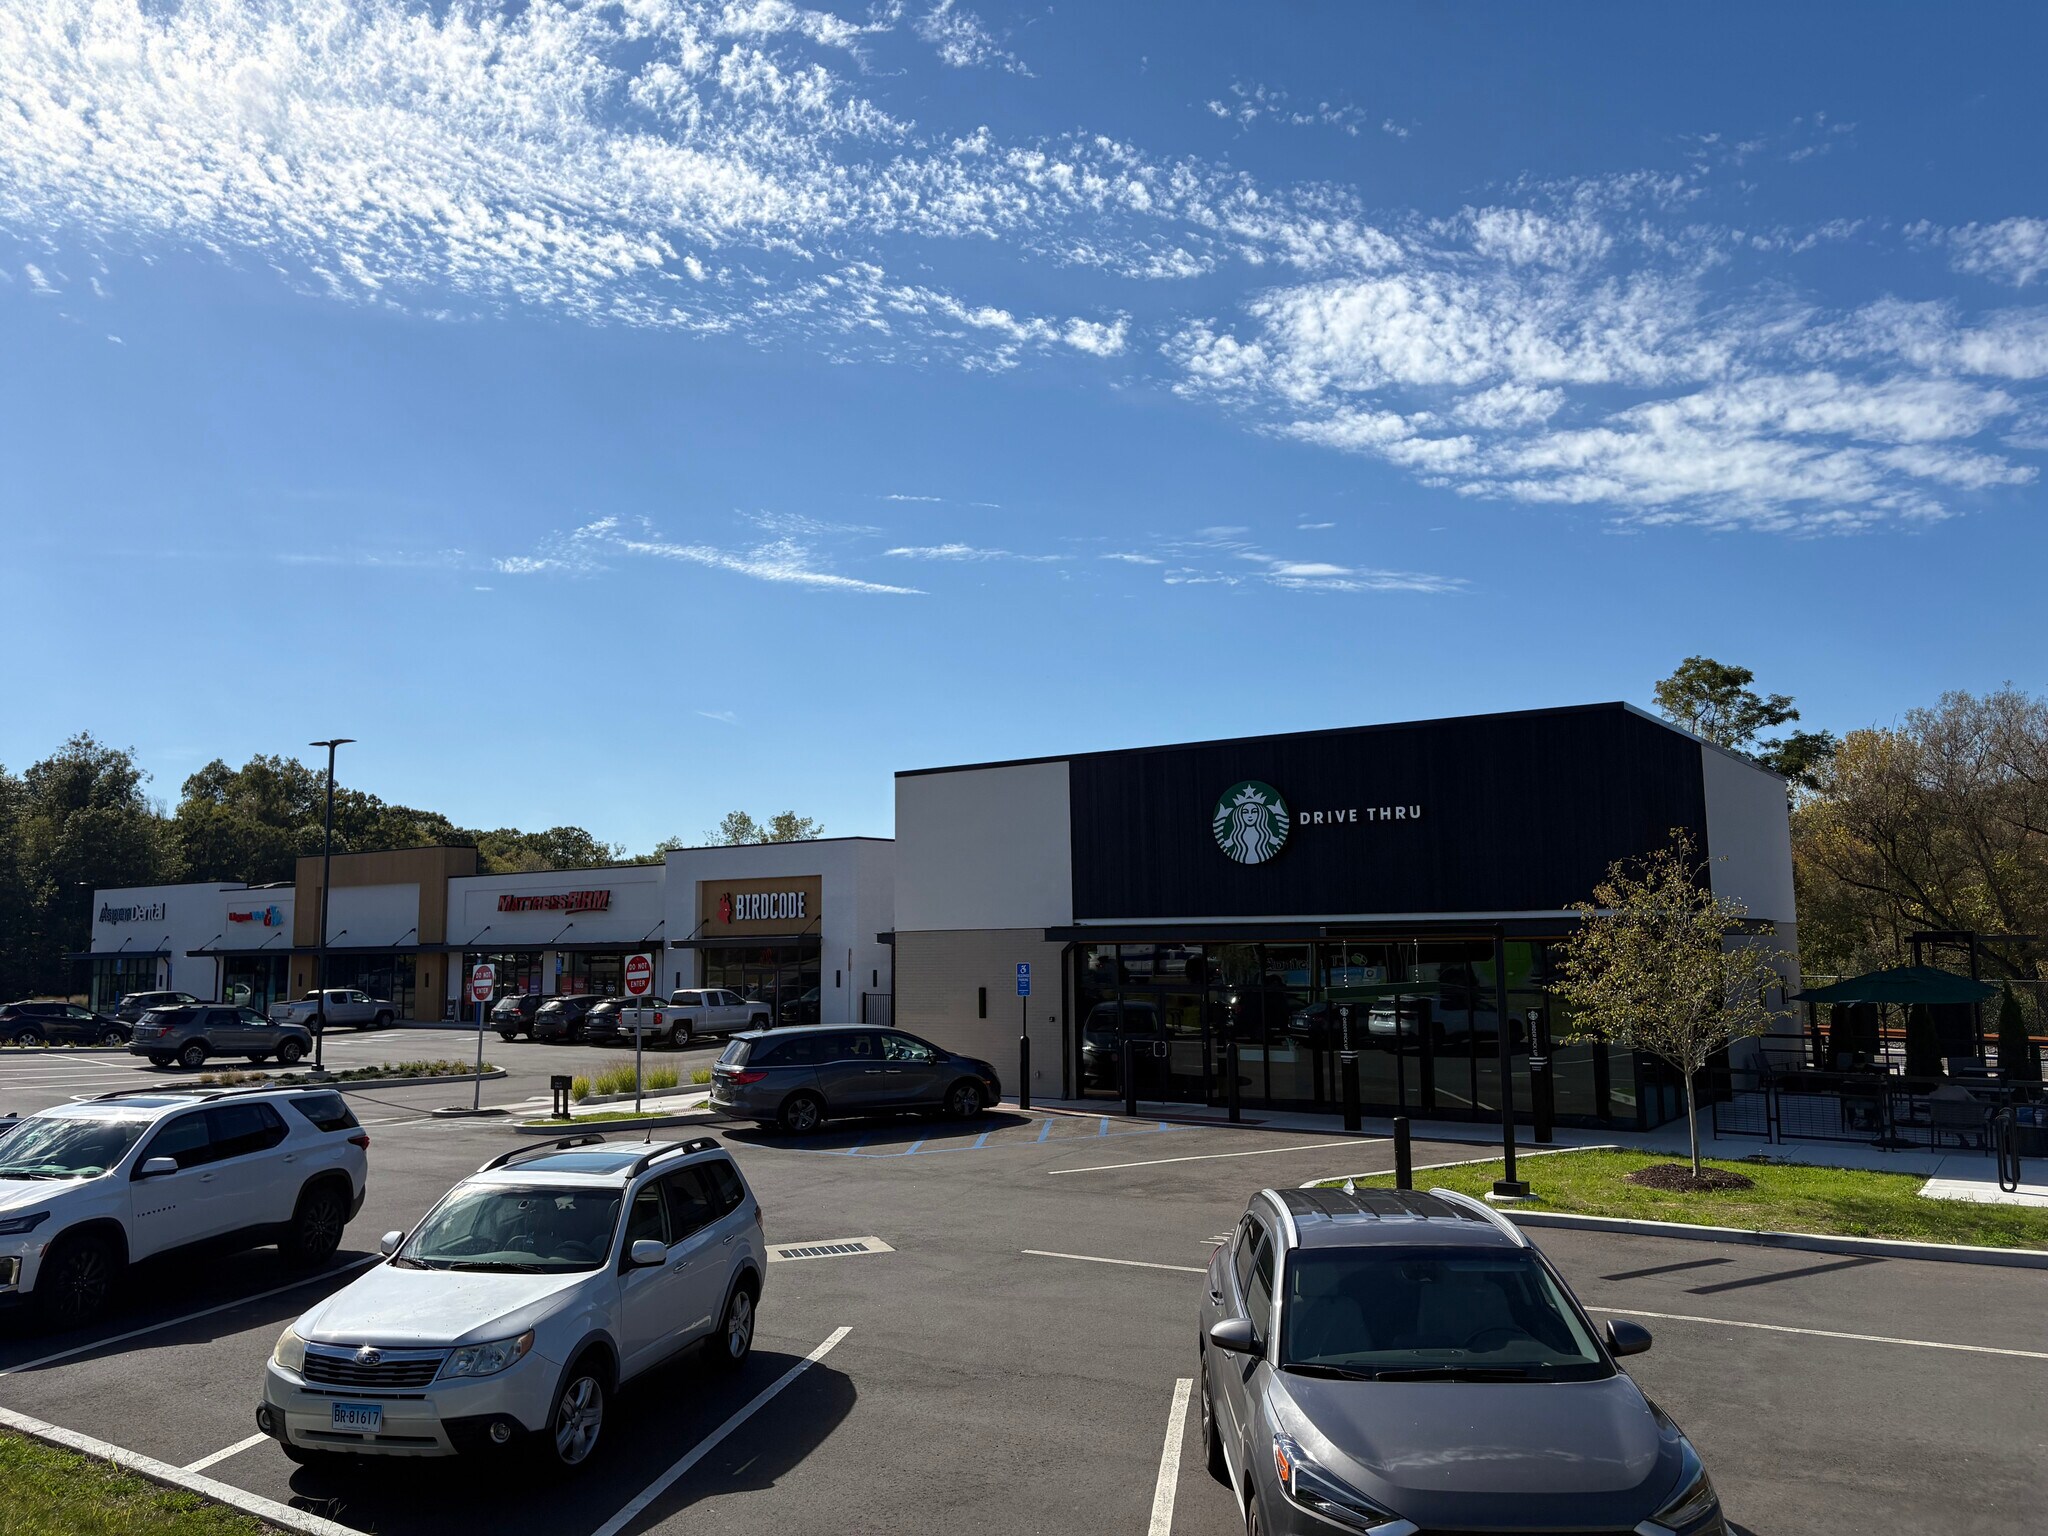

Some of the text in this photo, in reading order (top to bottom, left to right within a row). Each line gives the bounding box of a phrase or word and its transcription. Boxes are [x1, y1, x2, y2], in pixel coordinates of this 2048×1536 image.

[1300, 805, 1421, 825] DRIVE THRU
[736, 892, 806, 920] BIRDCODE
[630, 980, 646, 988] ENTER
